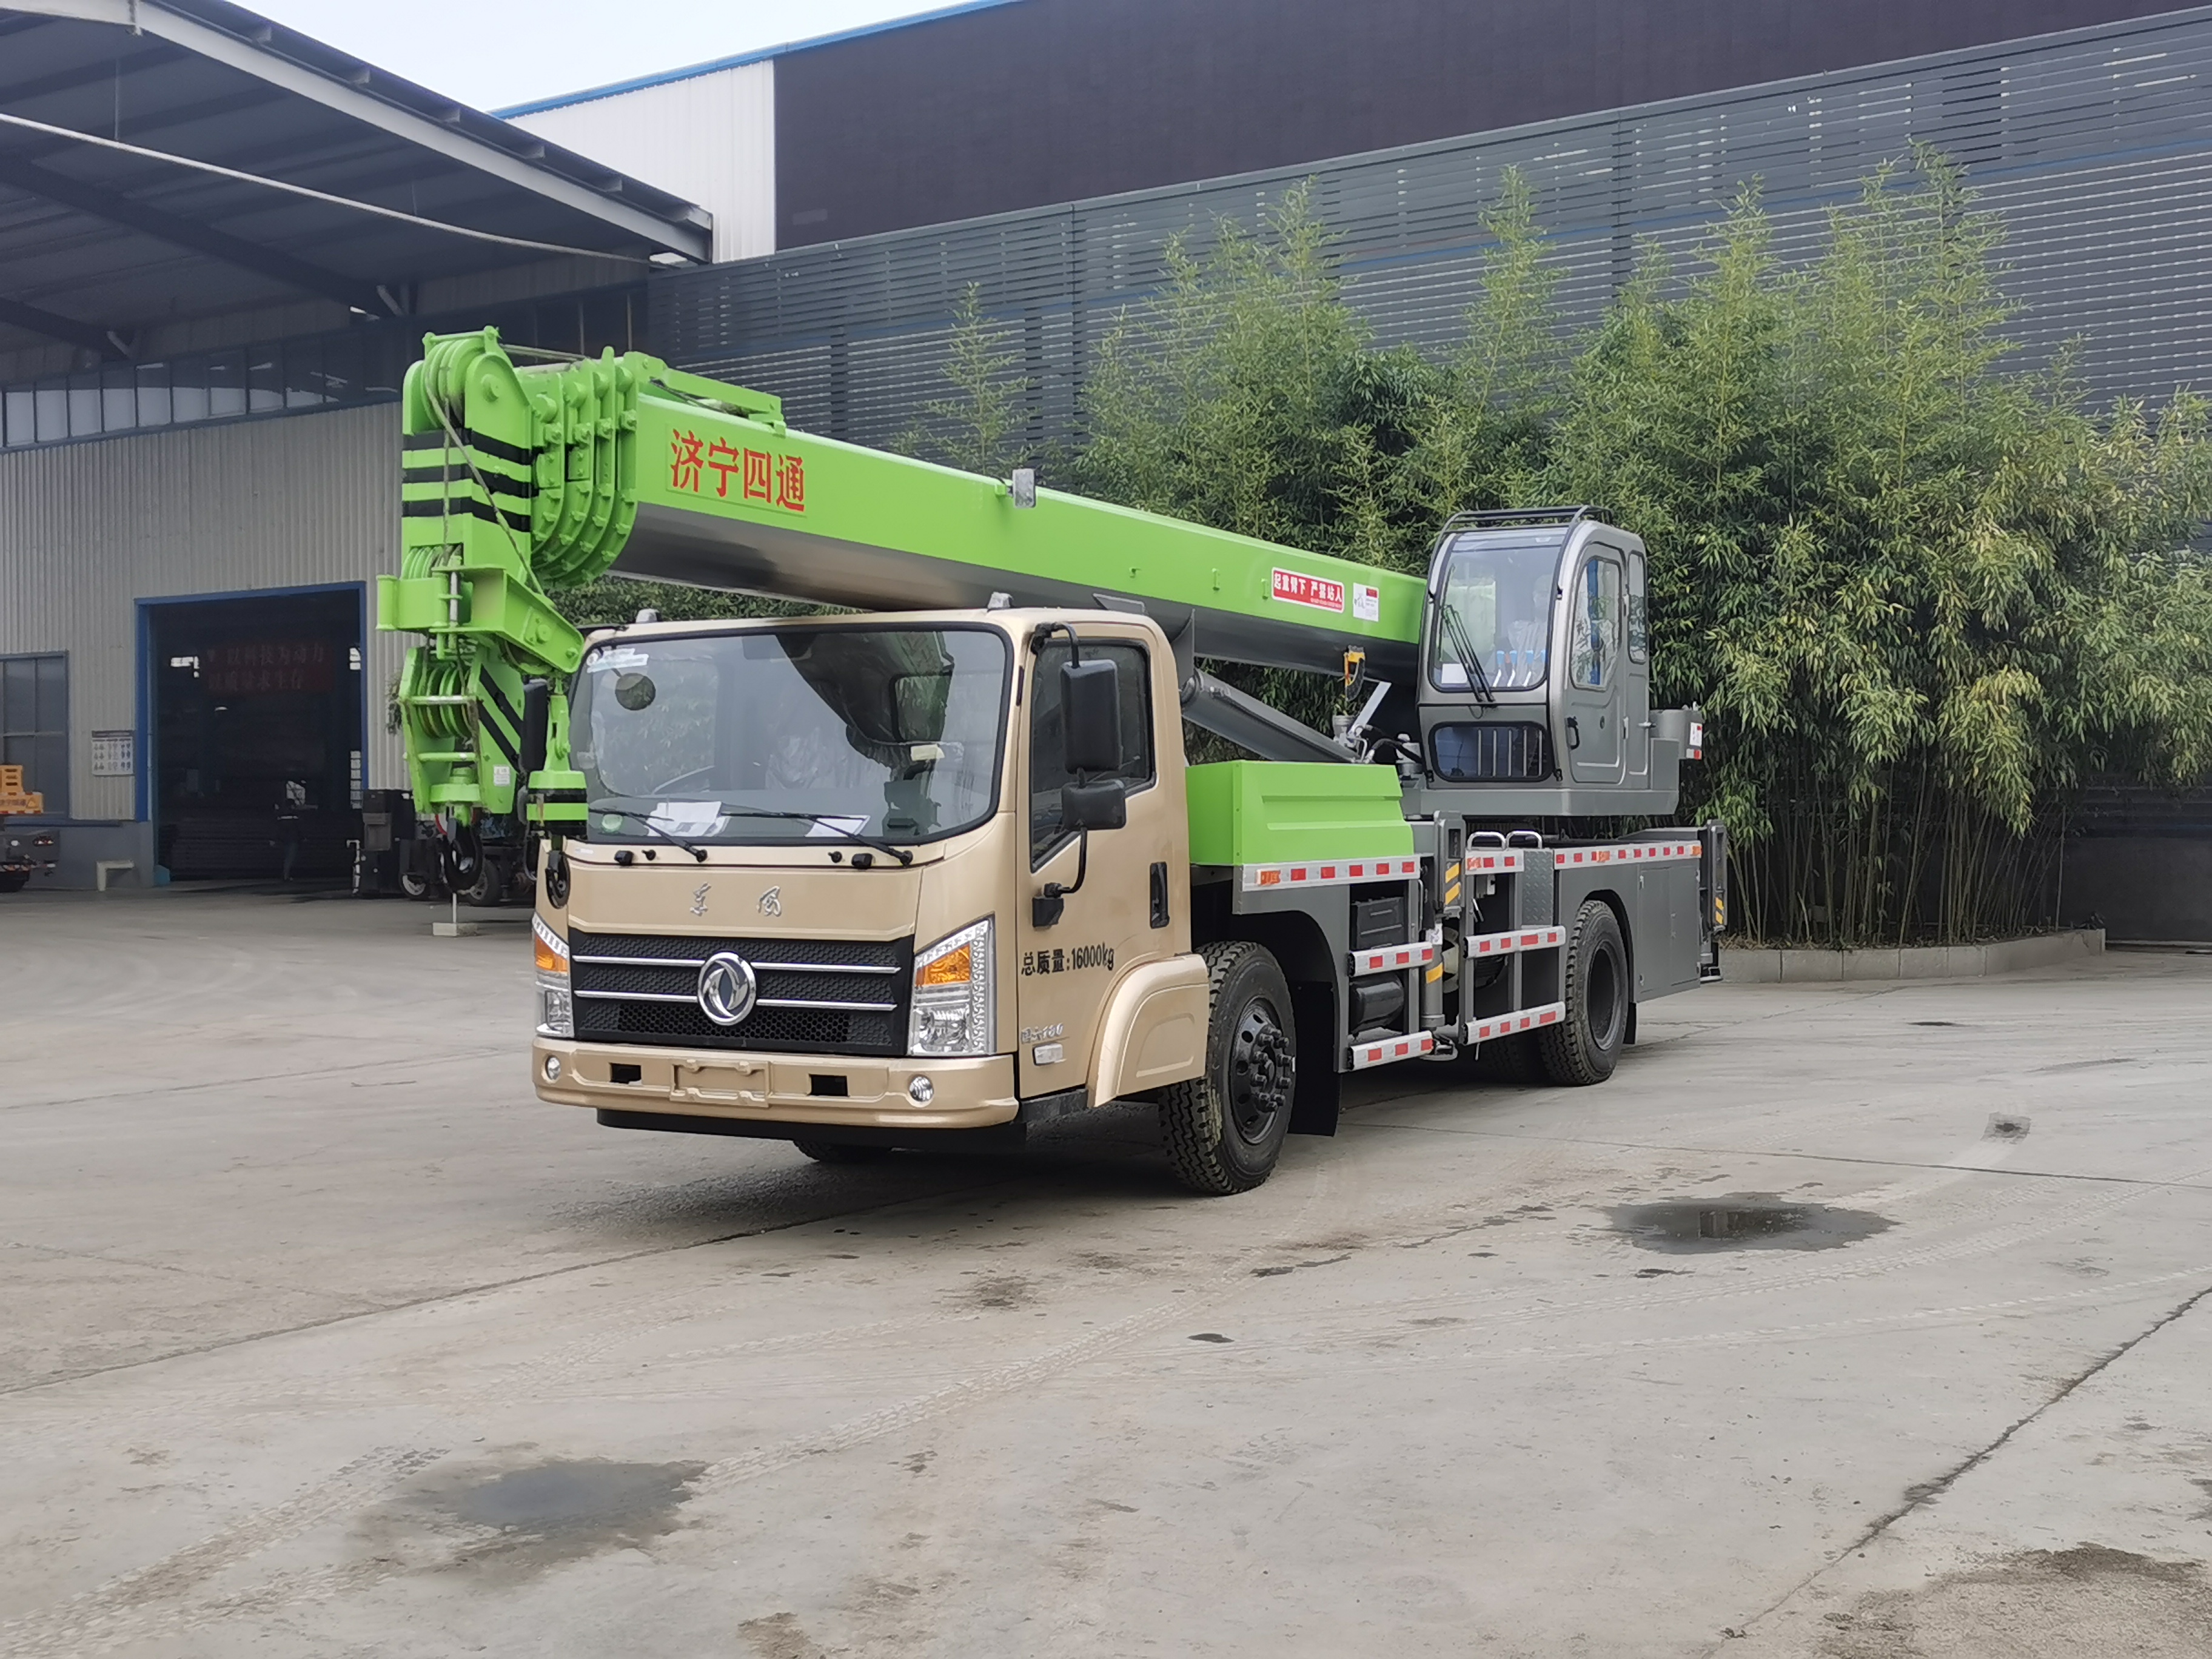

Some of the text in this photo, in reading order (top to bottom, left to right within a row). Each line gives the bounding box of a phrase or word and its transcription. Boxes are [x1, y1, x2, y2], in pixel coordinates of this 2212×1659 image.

[671, 428, 805, 511] 济宁四通
[1021, 942, 1114, 976] 总质量:16000kg
